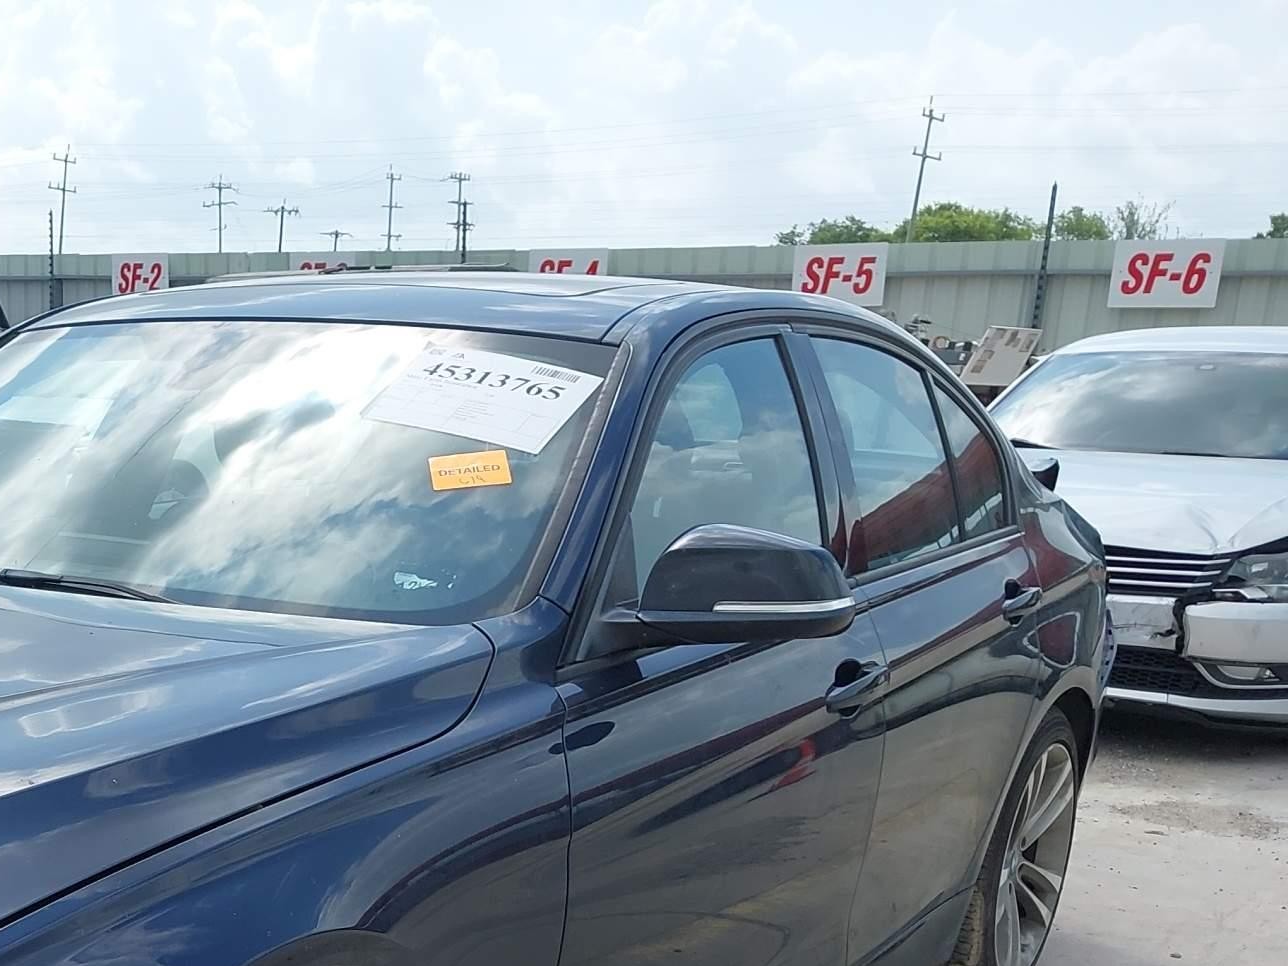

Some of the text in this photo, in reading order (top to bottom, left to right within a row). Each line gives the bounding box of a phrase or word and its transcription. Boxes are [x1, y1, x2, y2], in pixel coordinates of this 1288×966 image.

[118, 262, 162, 294] SF-2
[801, 256, 878, 295] SF-5
[1121, 252, 1212, 294] SF-6
[423, 362, 567, 400] 45313765
[438, 464, 501, 477] DETAILED
